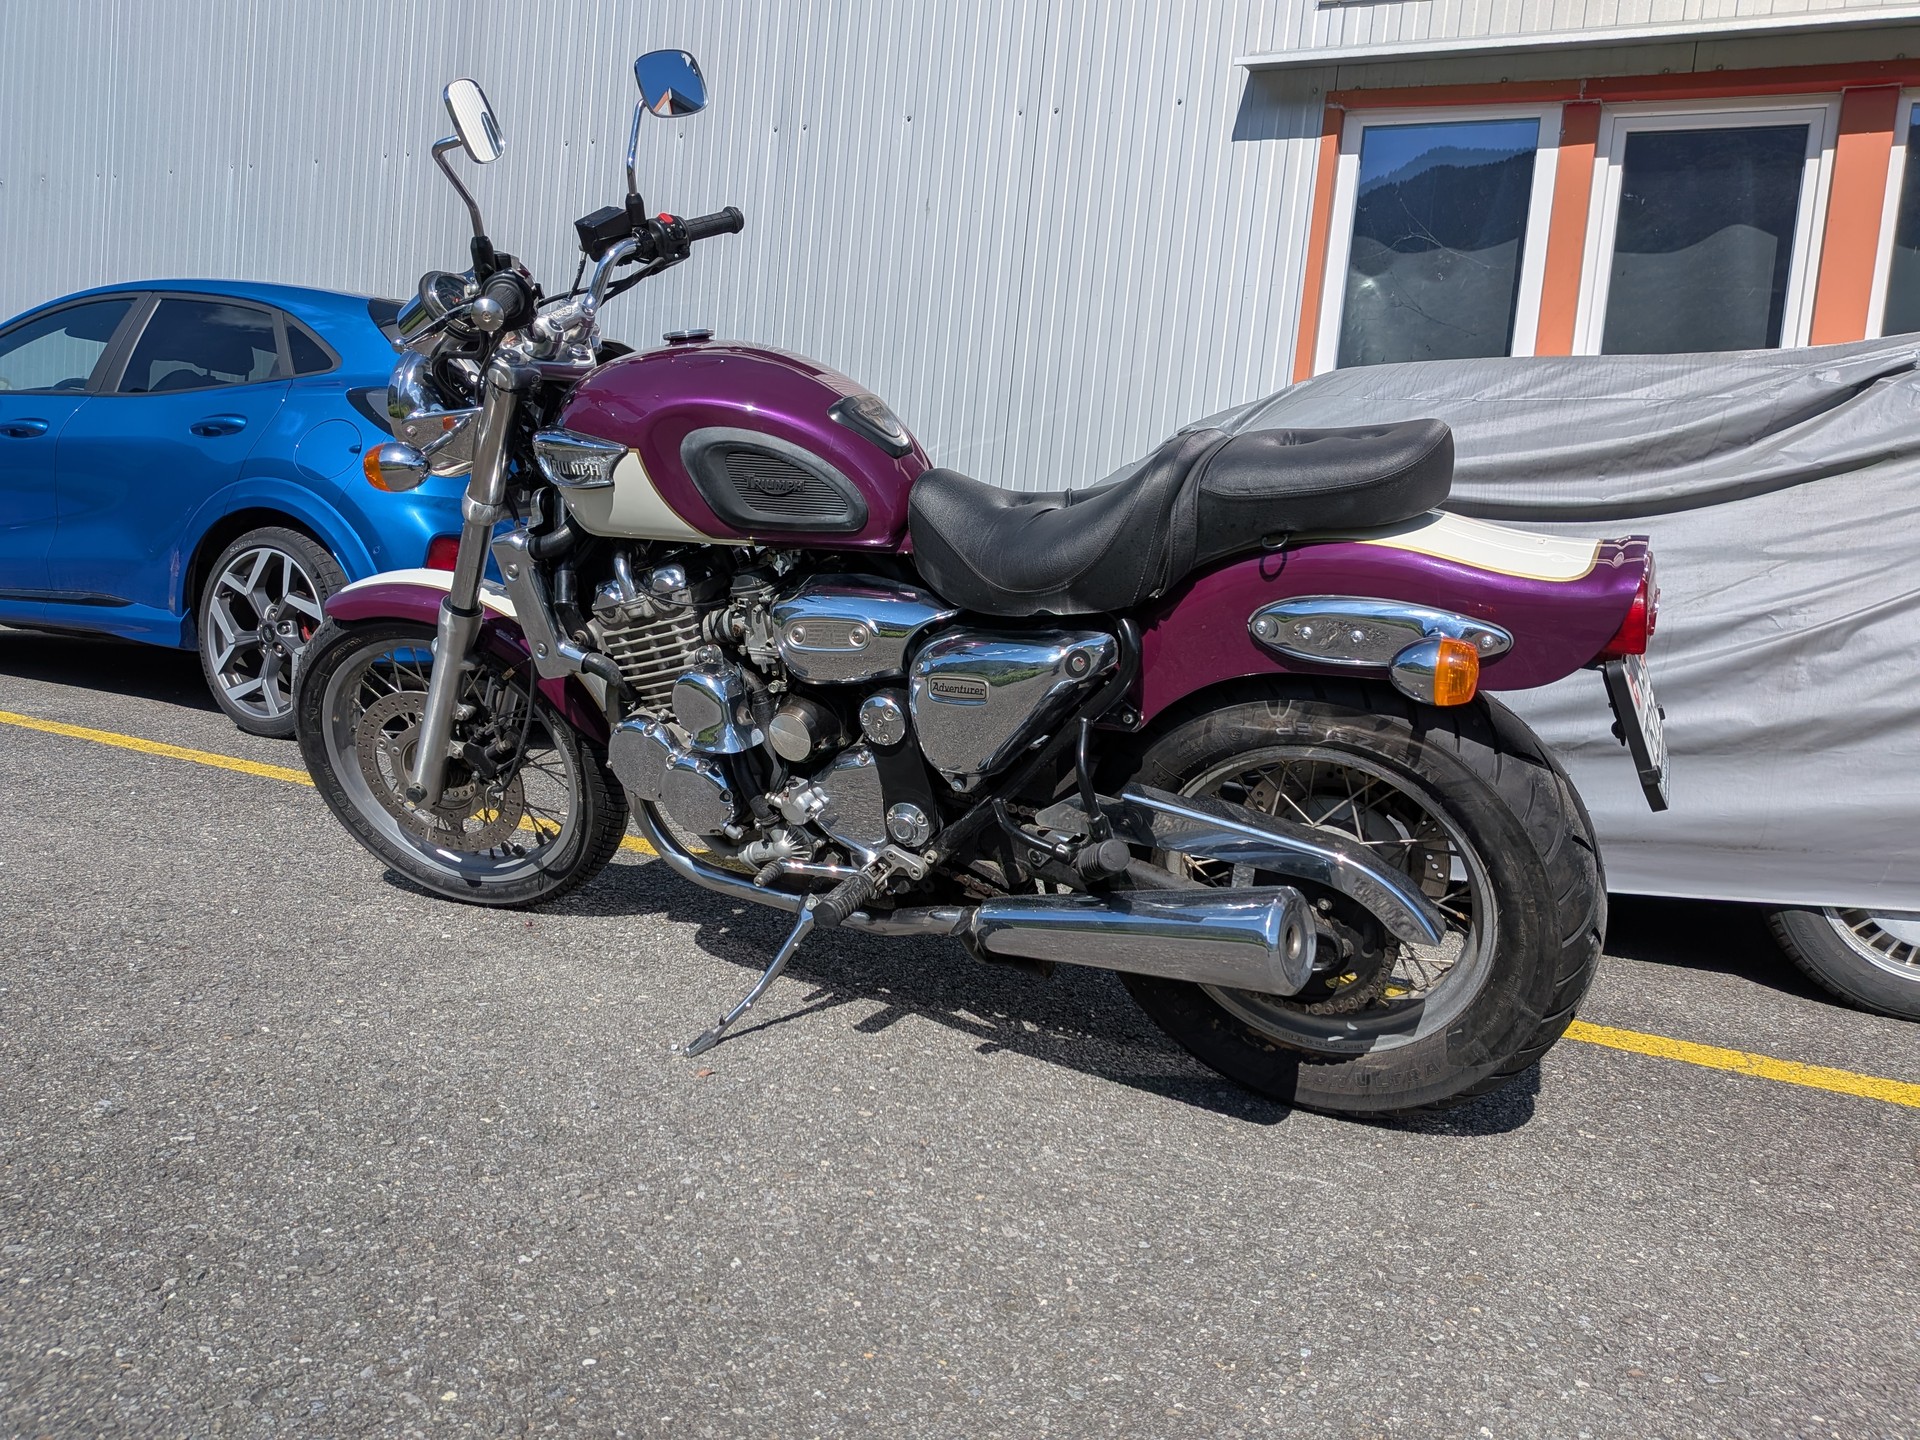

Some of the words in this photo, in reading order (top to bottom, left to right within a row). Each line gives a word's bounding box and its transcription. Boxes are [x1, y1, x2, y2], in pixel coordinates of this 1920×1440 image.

[544, 454, 601, 482] TRIUMPH
[743, 473, 805, 496] TRIUMPH
[932, 681, 986, 696] Adventurer
